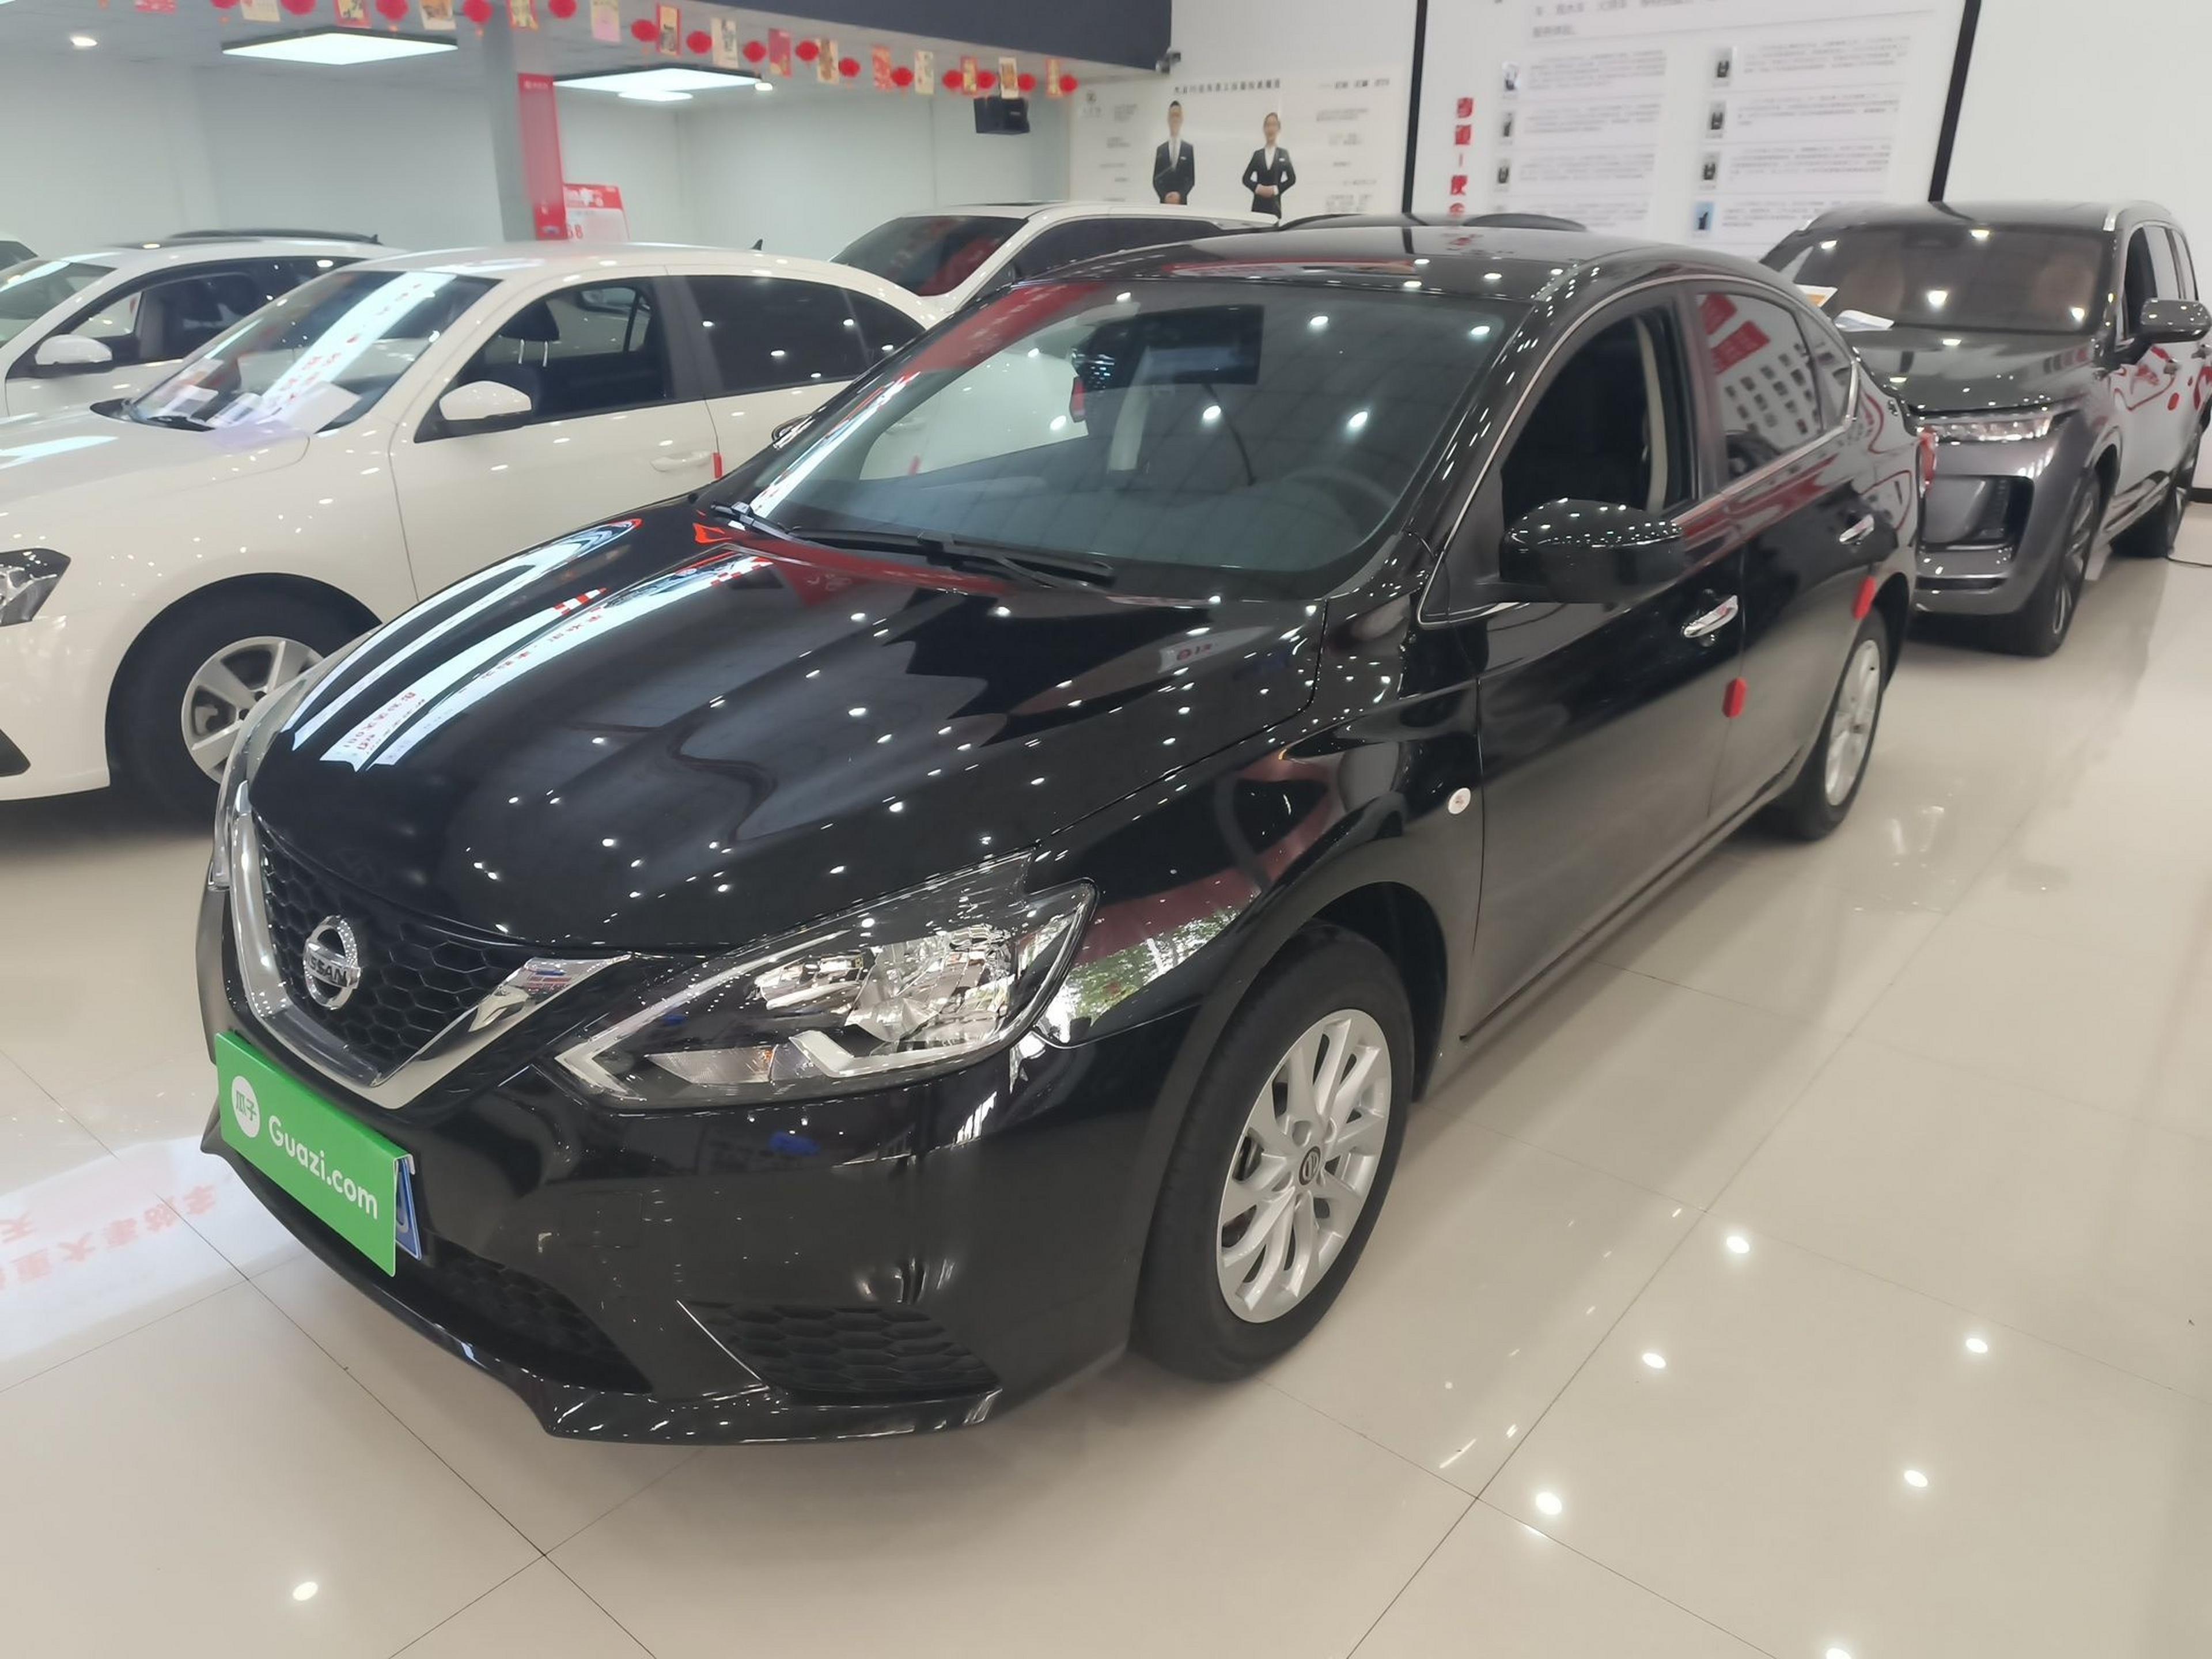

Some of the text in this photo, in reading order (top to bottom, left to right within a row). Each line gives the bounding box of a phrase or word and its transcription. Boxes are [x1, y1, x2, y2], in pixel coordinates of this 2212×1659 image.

[306, 950, 347, 987] SSAN
[236, 1090, 257, 1122] 瓜子
[268, 1115, 378, 1220] Guazi.com
